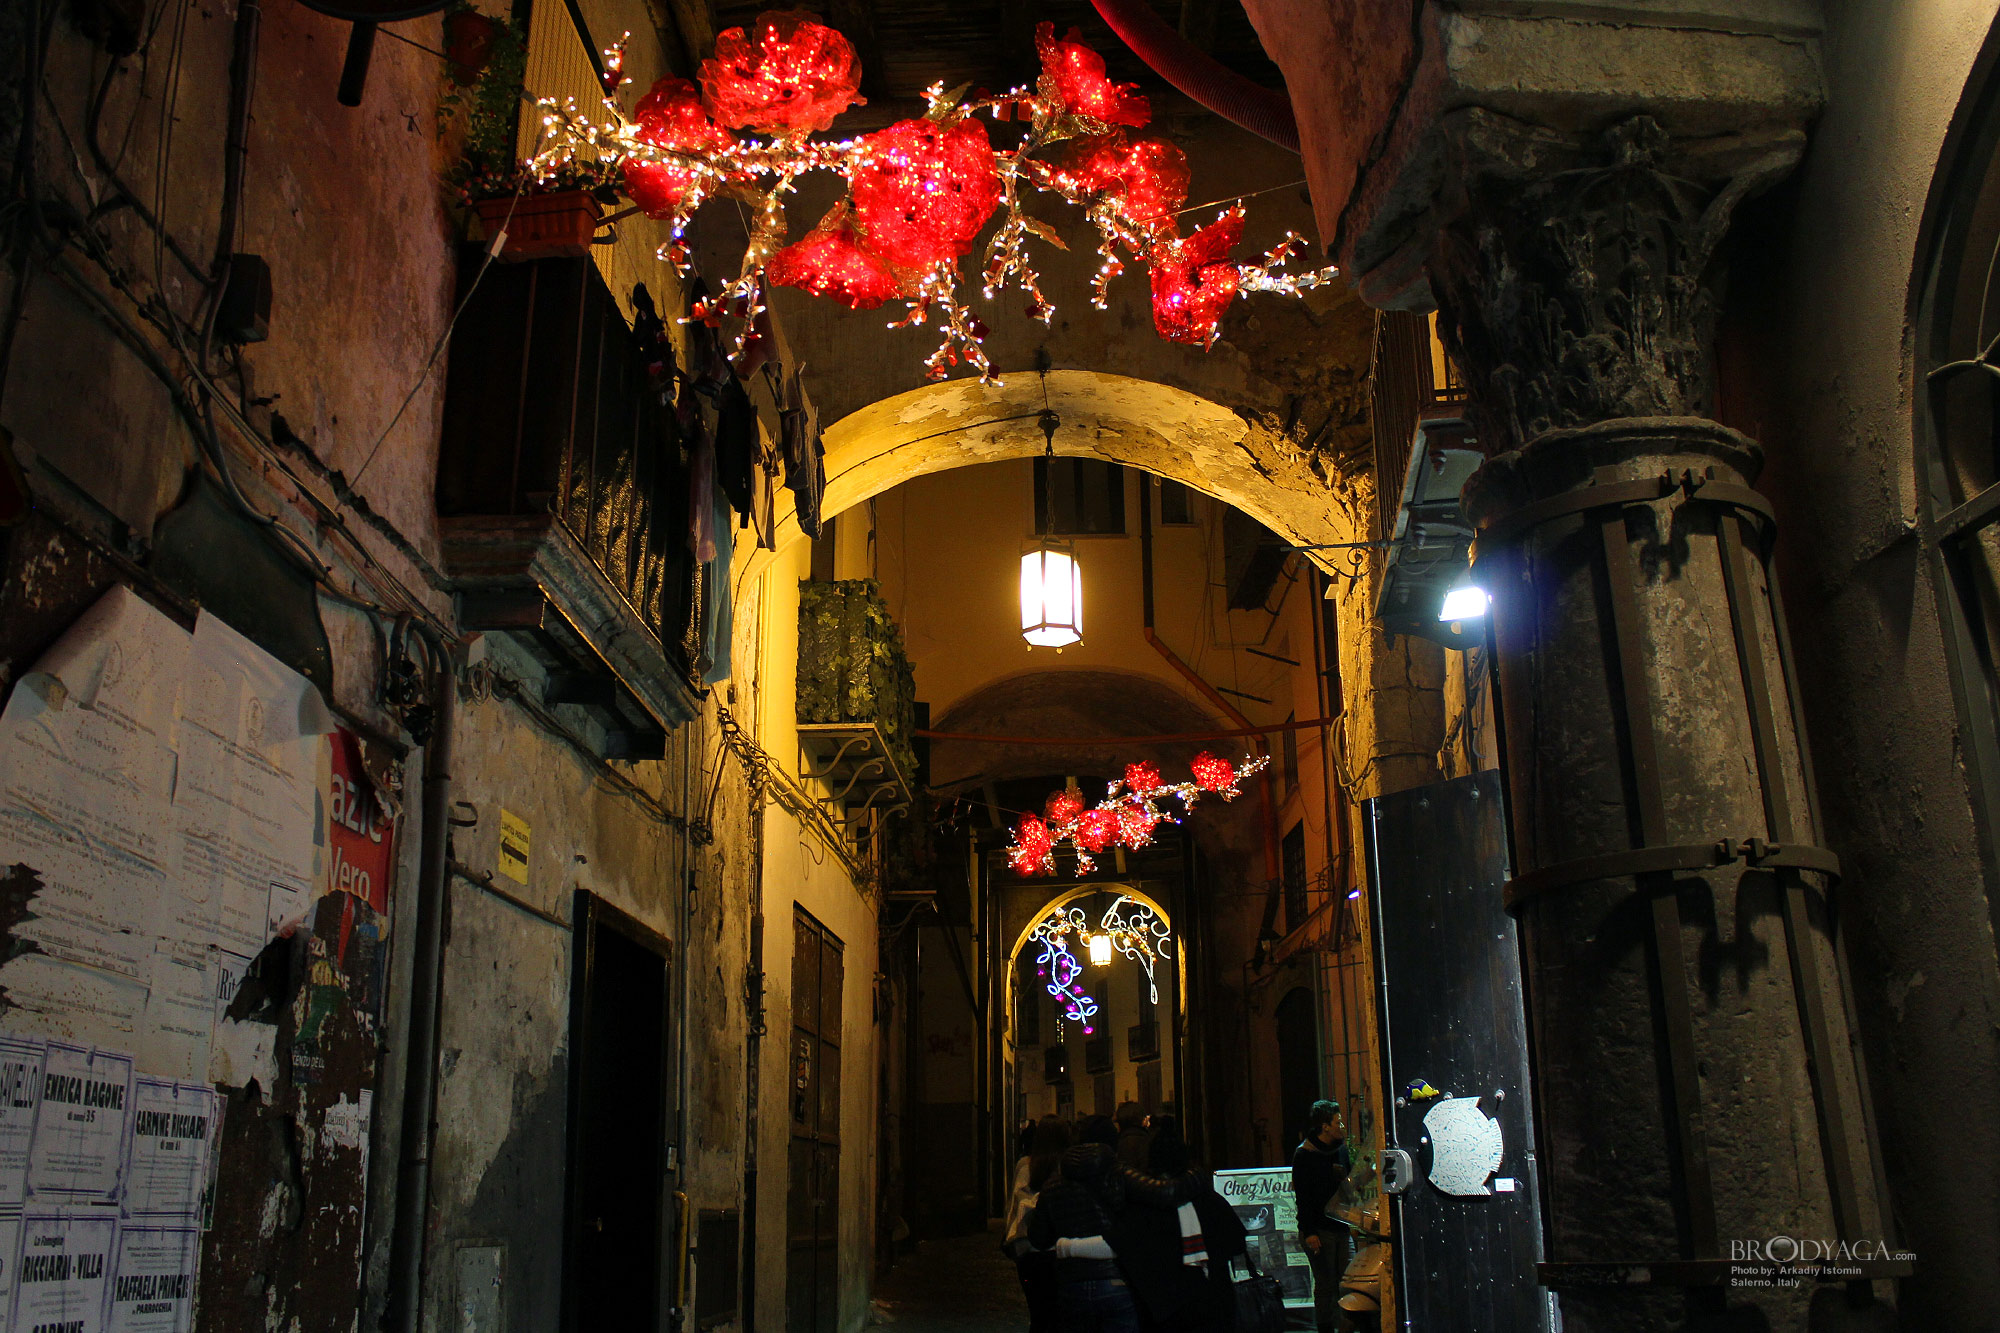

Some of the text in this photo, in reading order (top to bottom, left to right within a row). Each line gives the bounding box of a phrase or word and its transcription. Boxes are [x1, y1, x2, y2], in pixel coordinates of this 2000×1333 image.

[329, 846, 371, 901] Vero
[44, 1073, 82, 1106] ENRICA
[136, 1110, 170, 1137] CARMINE
[1223, 1179, 1257, 1201] Chez
[77, 1254, 103, 1280] VILLA
[116, 1275, 157, 1302] RAFFAELA
